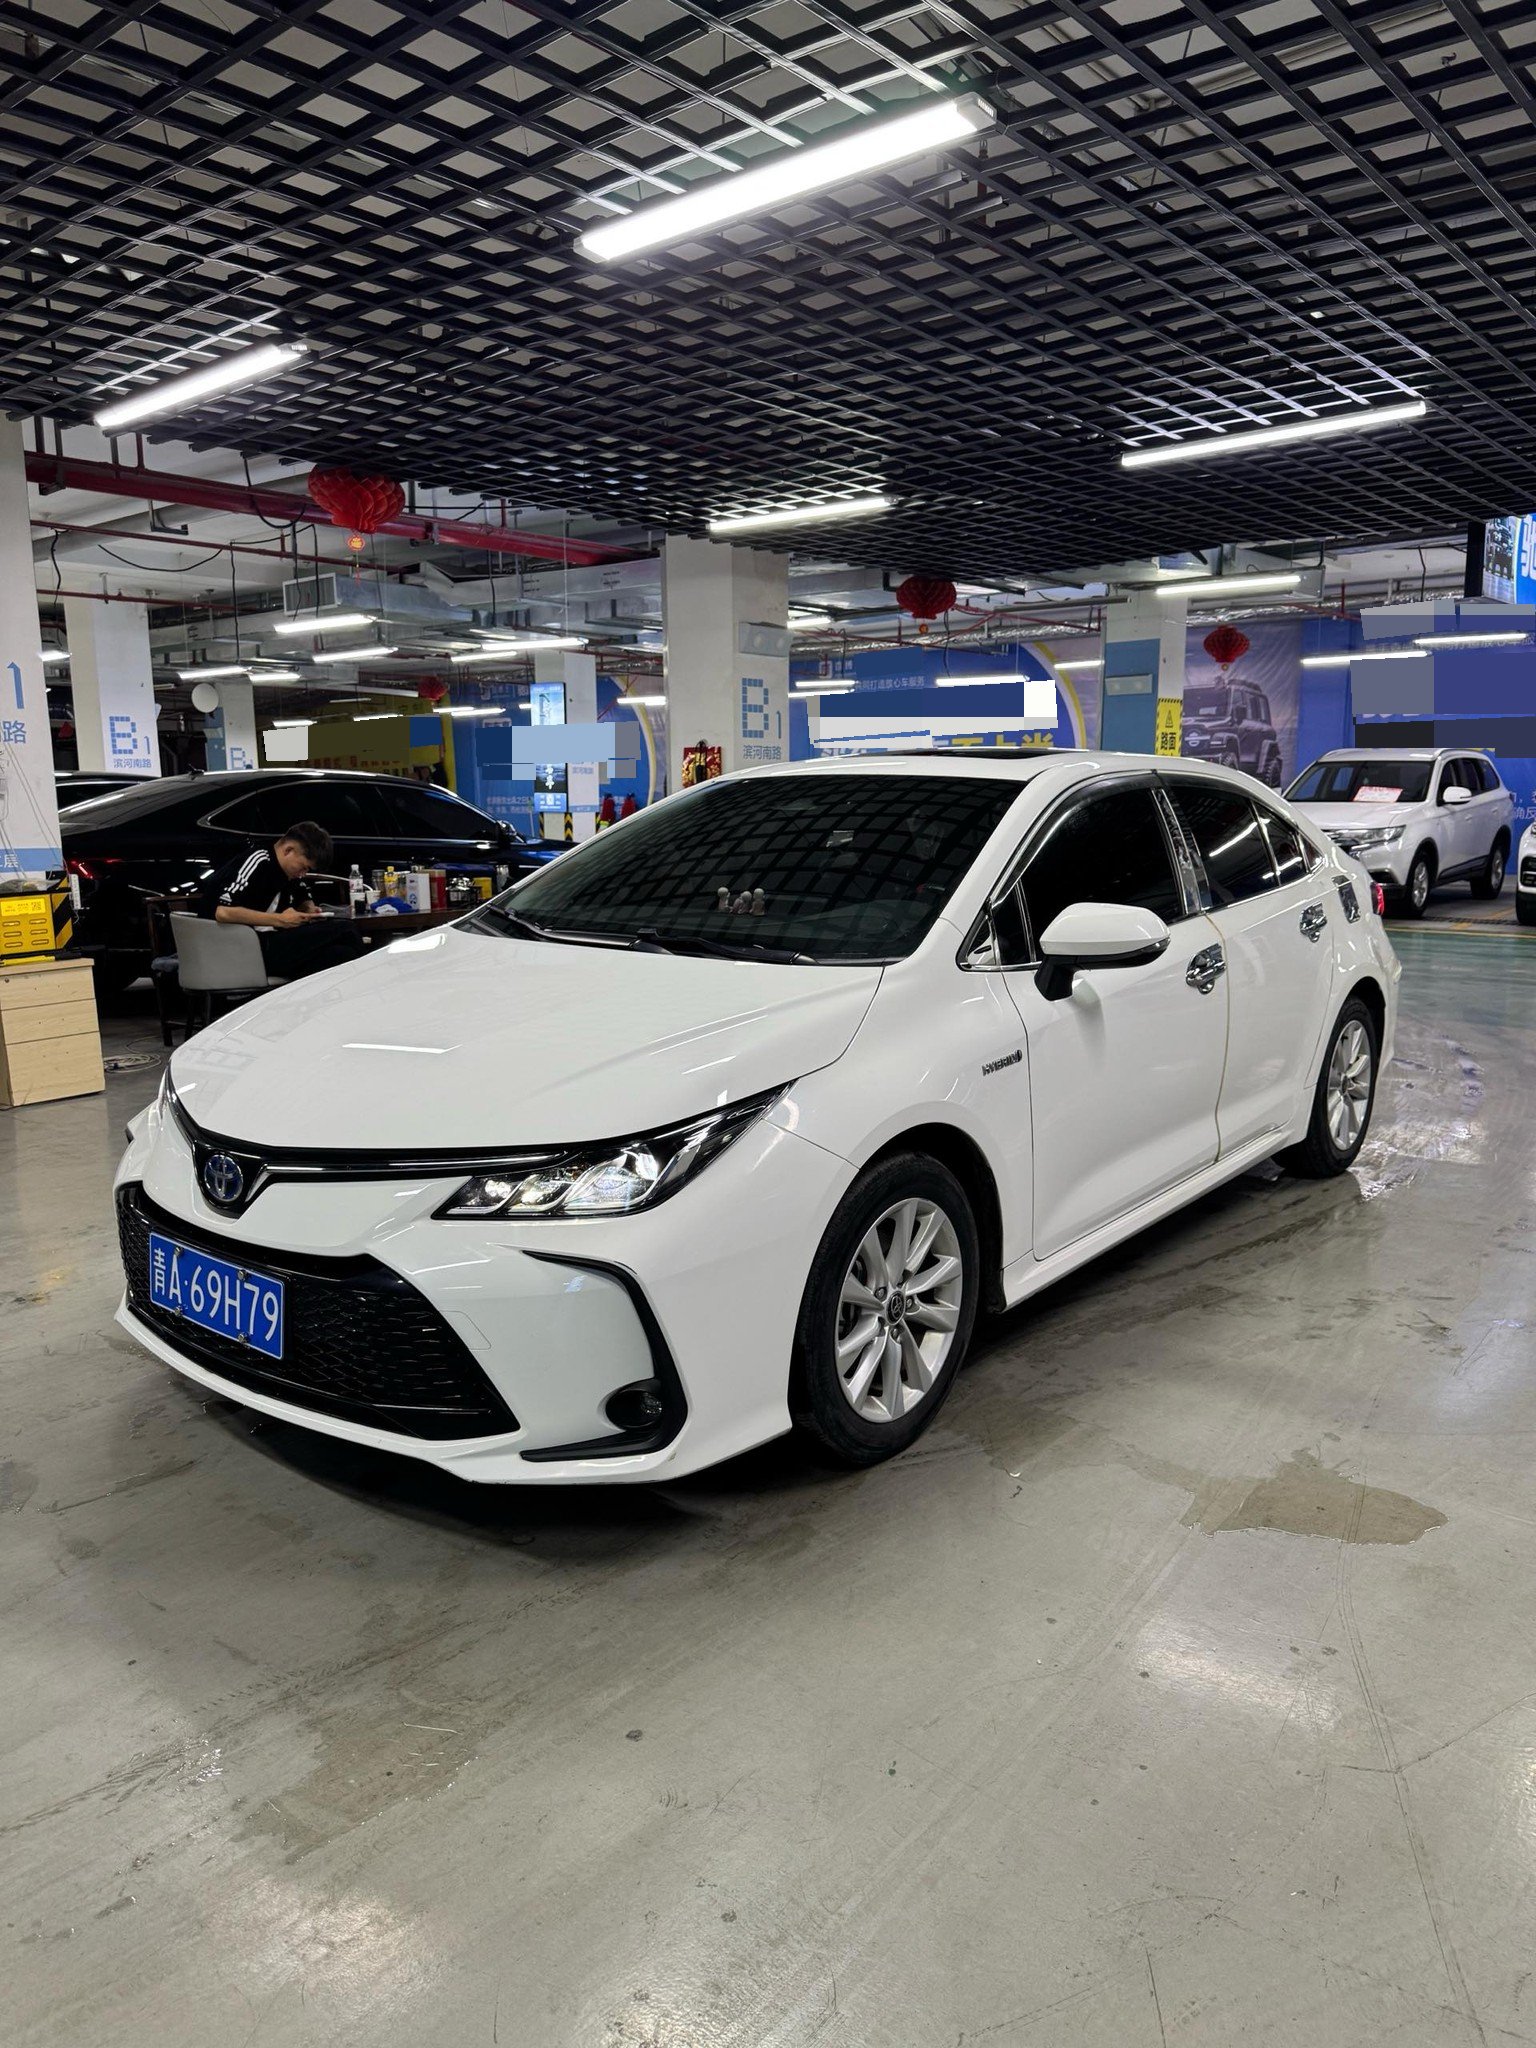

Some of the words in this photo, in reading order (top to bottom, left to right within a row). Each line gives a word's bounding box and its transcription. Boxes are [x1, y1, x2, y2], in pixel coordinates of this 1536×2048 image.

[742, 678, 781, 739] B1
[0, 720, 26, 743] 路
[109, 716, 150, 754] B1
[743, 745, 781, 760] 滨河南路
[113, 758, 151, 768] 滨河南路
[0, 854, 19, 868] 层
